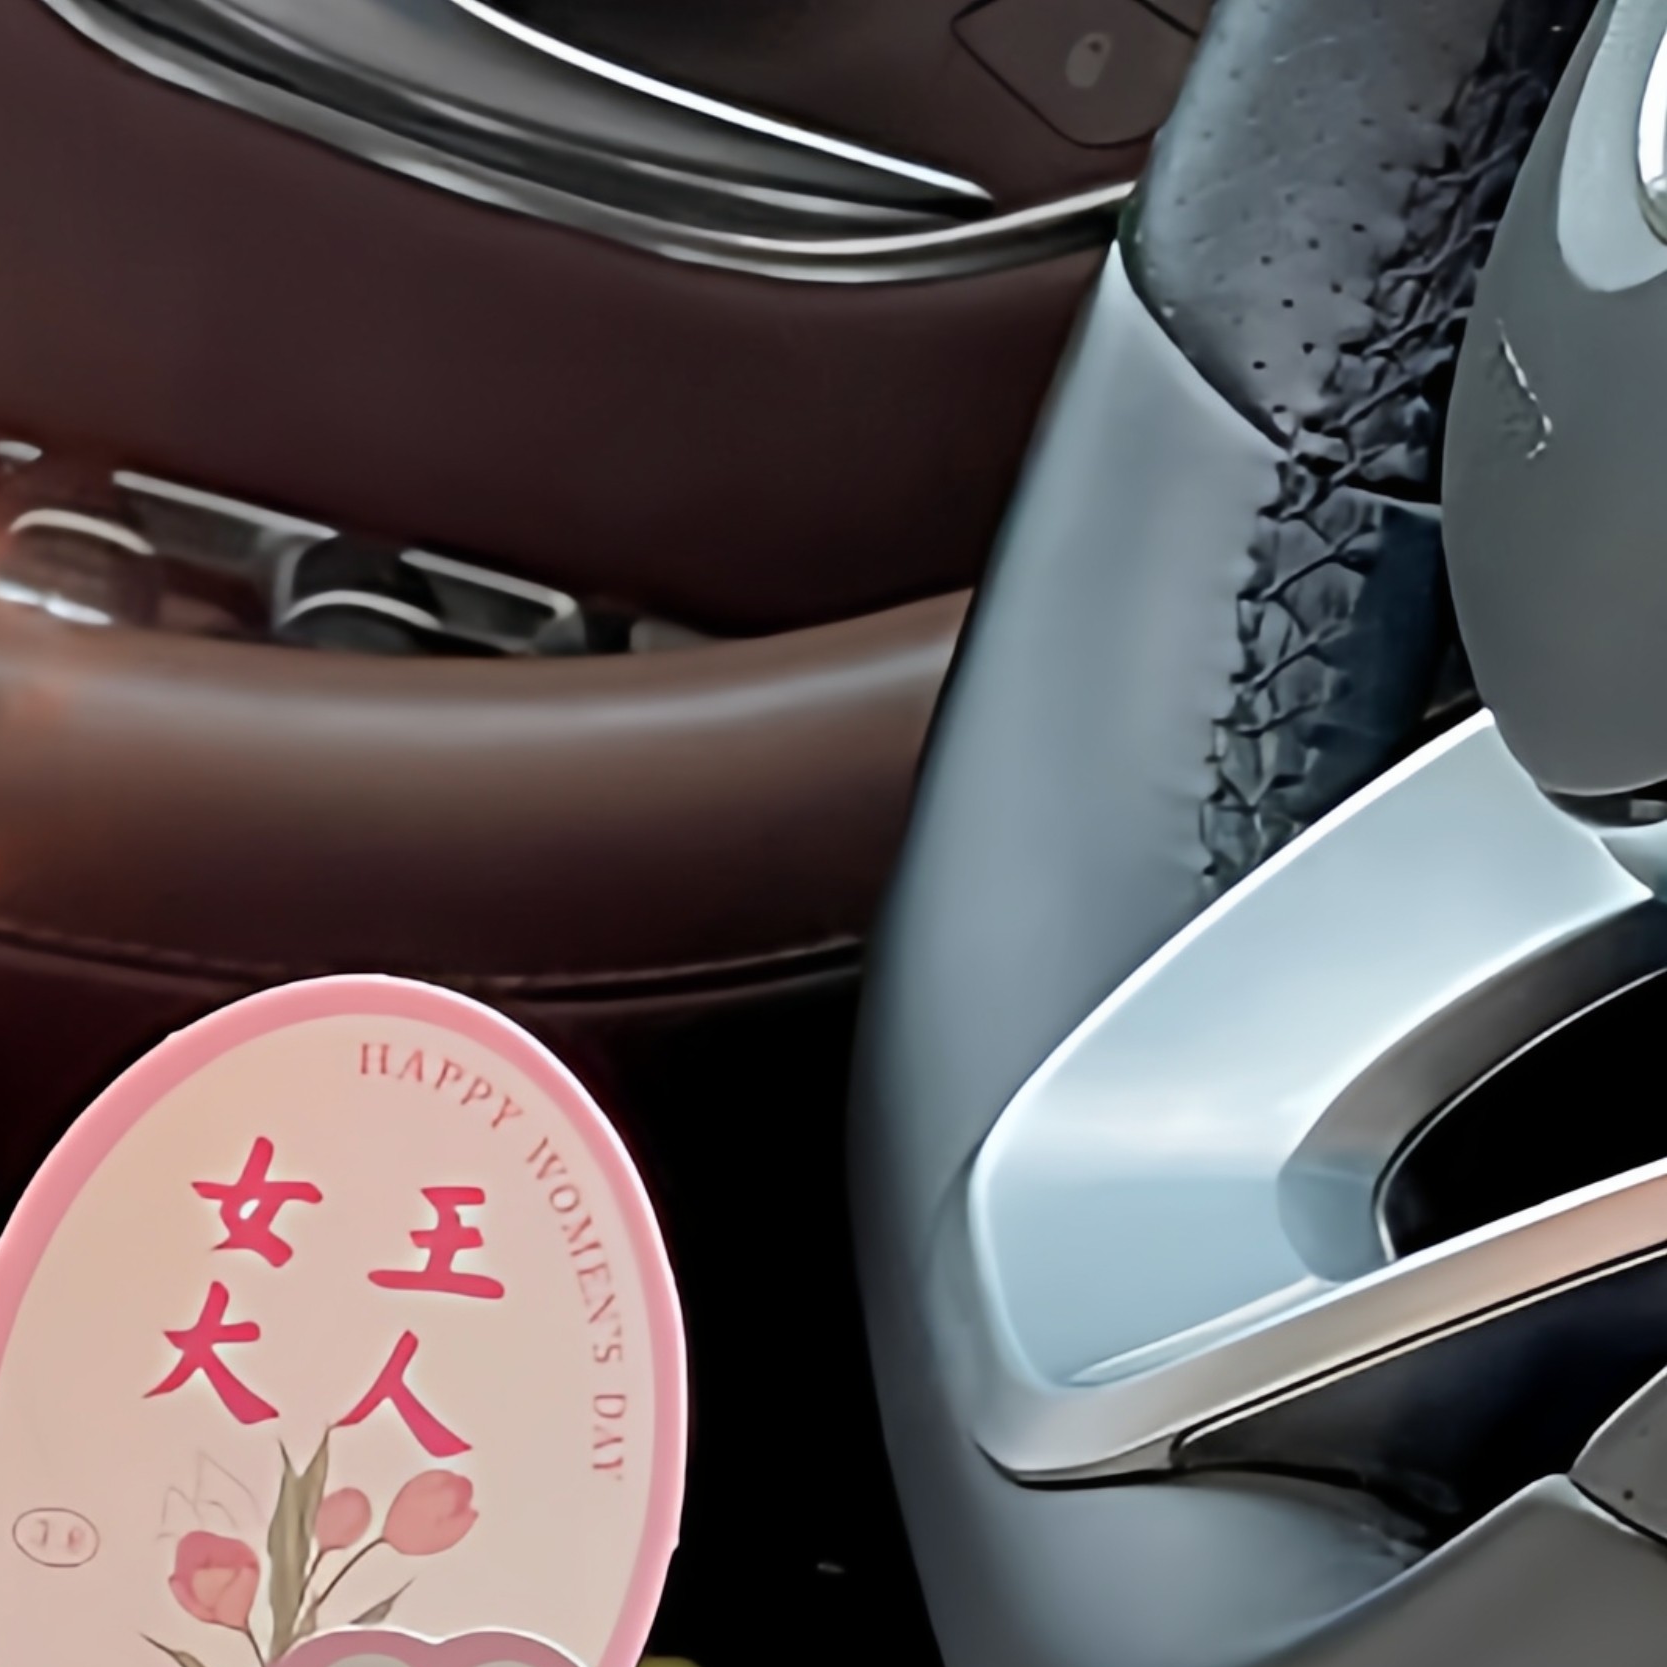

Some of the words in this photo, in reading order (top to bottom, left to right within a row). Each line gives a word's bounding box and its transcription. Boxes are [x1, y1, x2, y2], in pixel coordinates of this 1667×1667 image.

[359, 1043, 525, 1130] HAPPY
[525, 1136, 623, 1365] WOMEN'S
[591, 1393, 627, 1482] DAY
